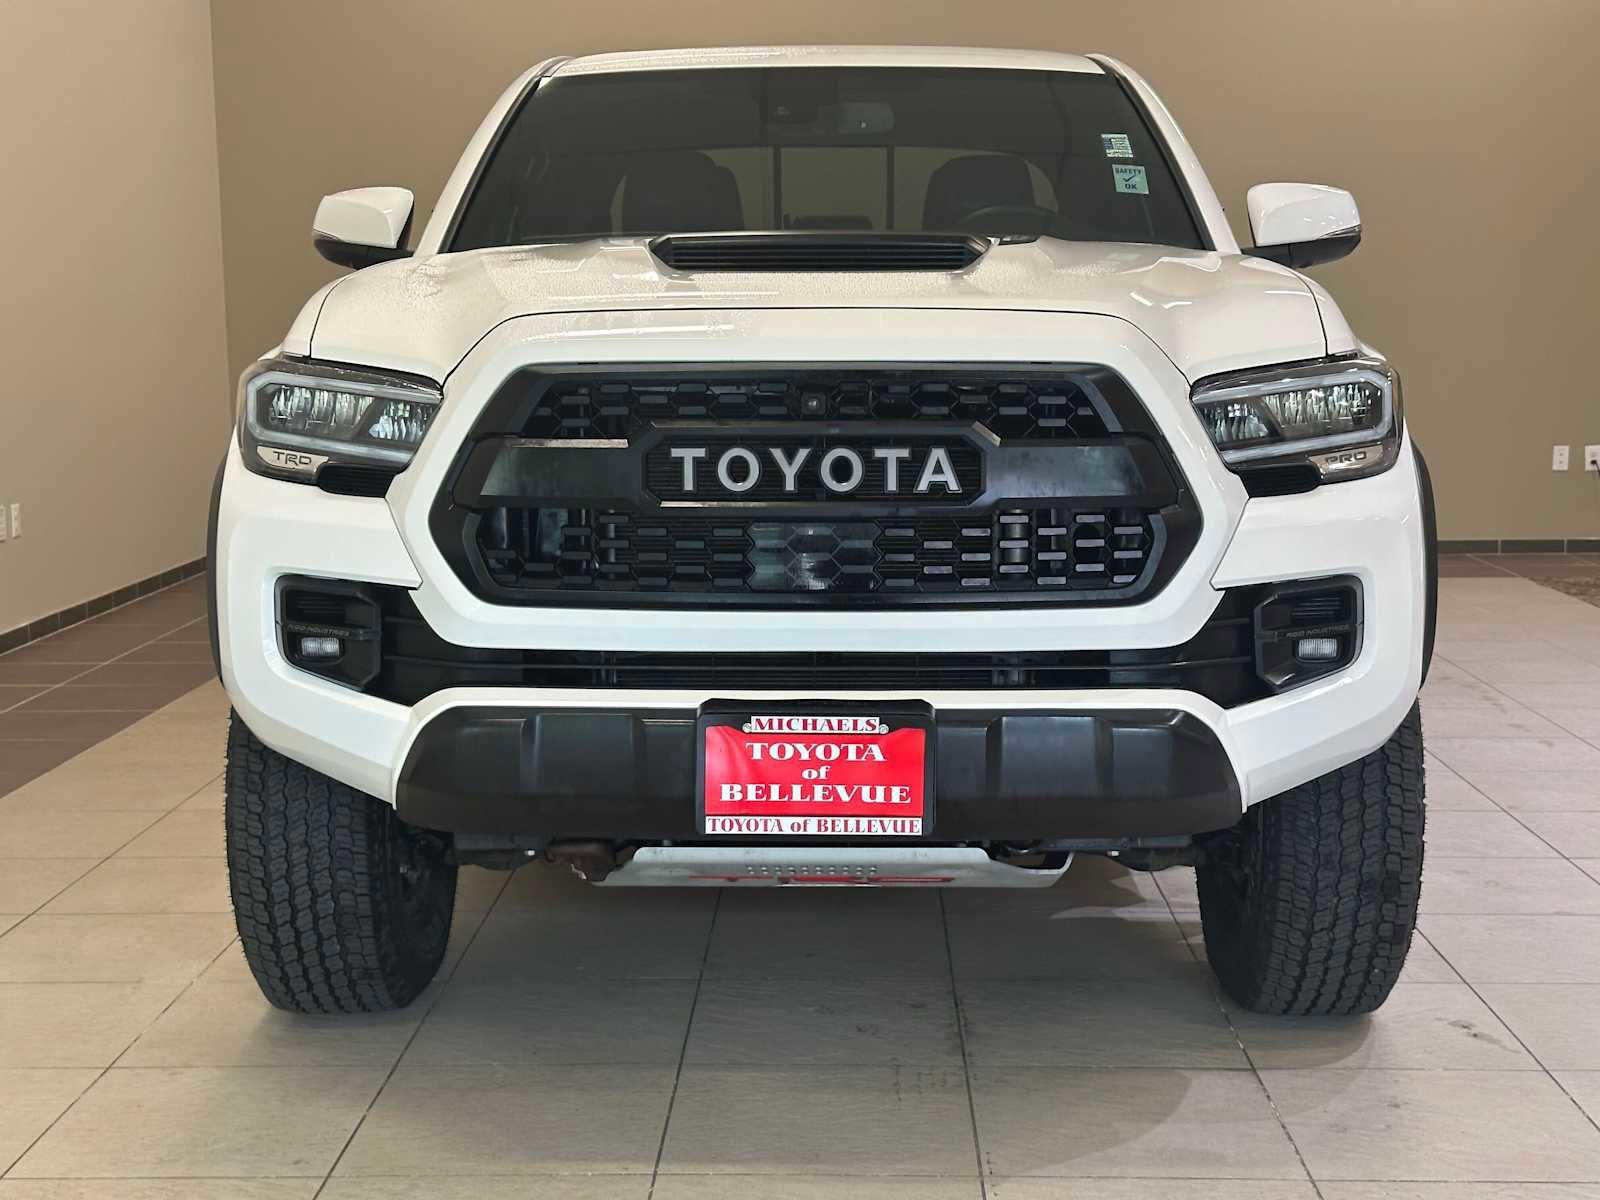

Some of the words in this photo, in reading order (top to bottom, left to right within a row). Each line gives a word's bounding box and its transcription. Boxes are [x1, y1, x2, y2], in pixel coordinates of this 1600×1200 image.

[1114, 167, 1142, 175] SAFETY
[272, 451, 312, 466] TRD
[1326, 451, 1367, 463] PRO
[671, 447, 962, 493] TOYOTA
[754, 717, 877, 732] MICHAELS
[745, 742, 886, 762] TOYOTA
[802, 765, 831, 780] of
[719, 784, 911, 804] BELLEVUE
[708, 817, 784, 833] TOYOTA
[790, 818, 811, 833] of
[817, 818, 920, 834] BELLEVUE
